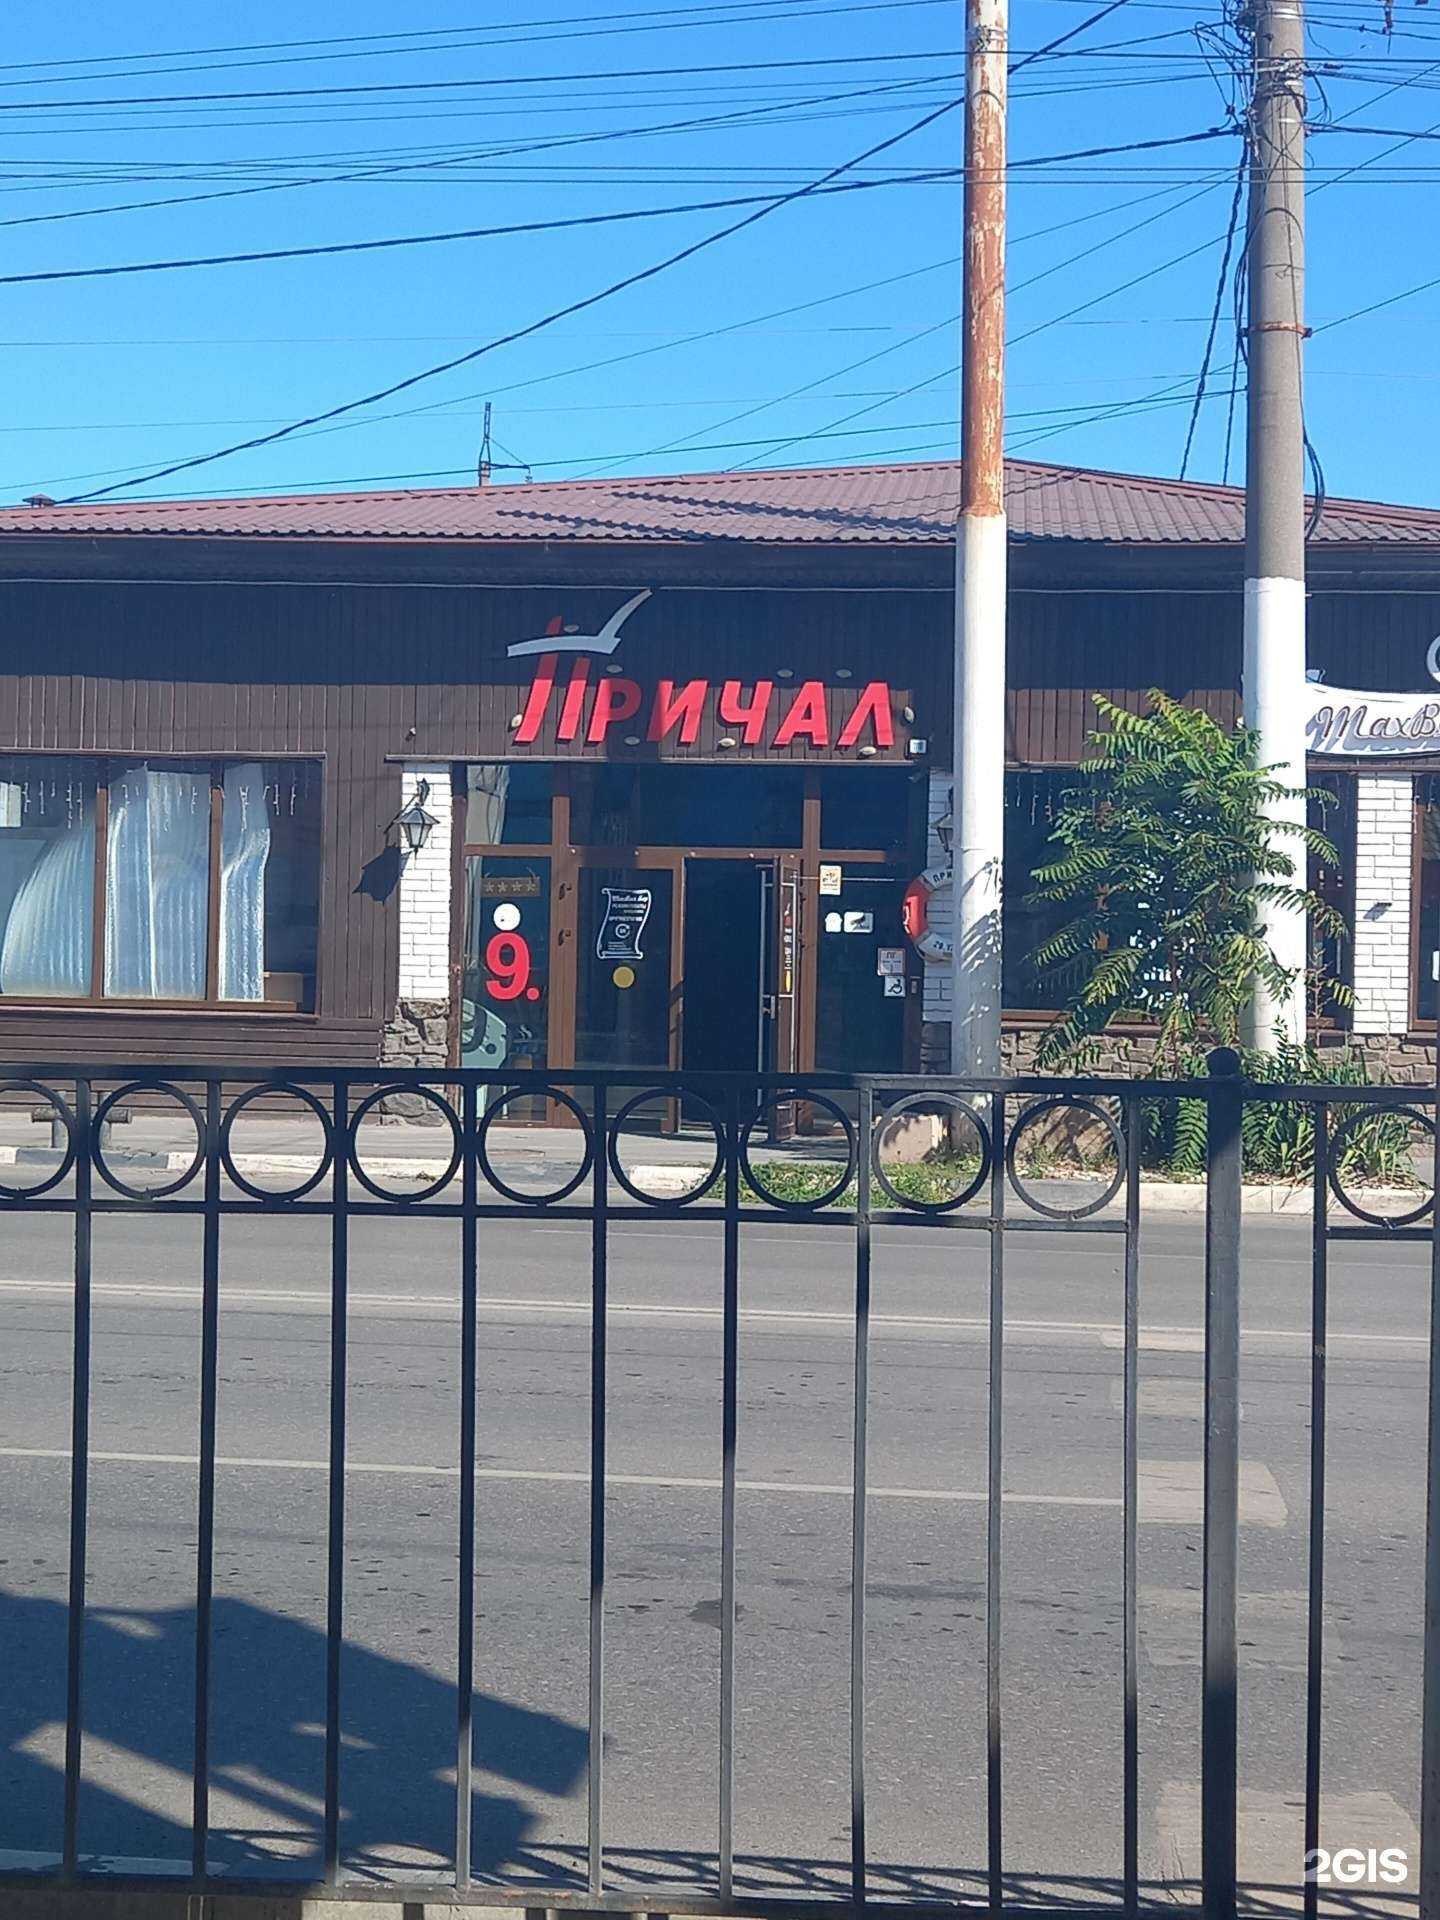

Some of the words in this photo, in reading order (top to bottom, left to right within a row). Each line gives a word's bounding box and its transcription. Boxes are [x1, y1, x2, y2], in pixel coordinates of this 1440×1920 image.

[511, 614, 896, 748] ПРИЧАЛ
[1313, 703, 1440, 740] MaxB
[932, 870, 953, 883] ПРИ
